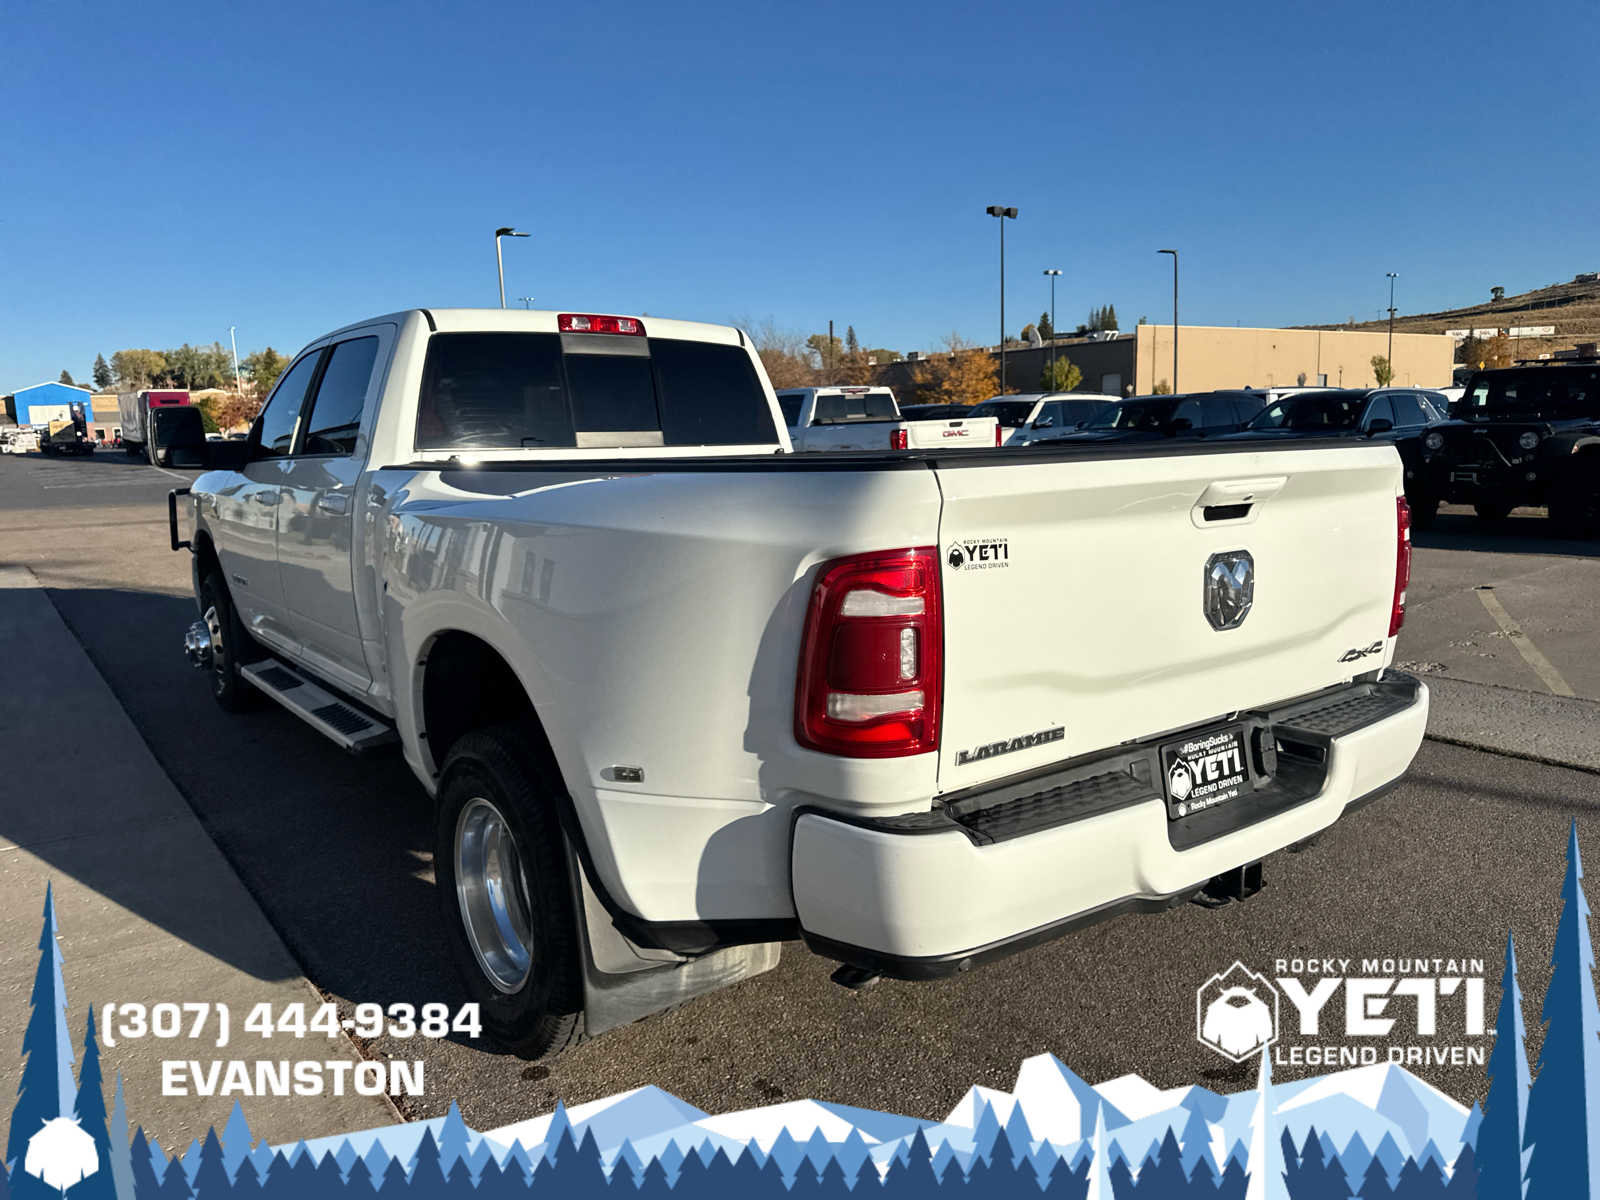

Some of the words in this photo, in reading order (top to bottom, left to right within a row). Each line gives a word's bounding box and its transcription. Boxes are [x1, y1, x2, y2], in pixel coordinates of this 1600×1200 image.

[964, 543, 1009, 562] YETI
[964, 563, 987, 571] LEGEND
[955, 726, 1065, 767] LARAMIE
[1189, 747, 1241, 785] YETI
[1191, 783, 1218, 799] LEGEND
[1218, 774, 1243, 790] DRIVEN
